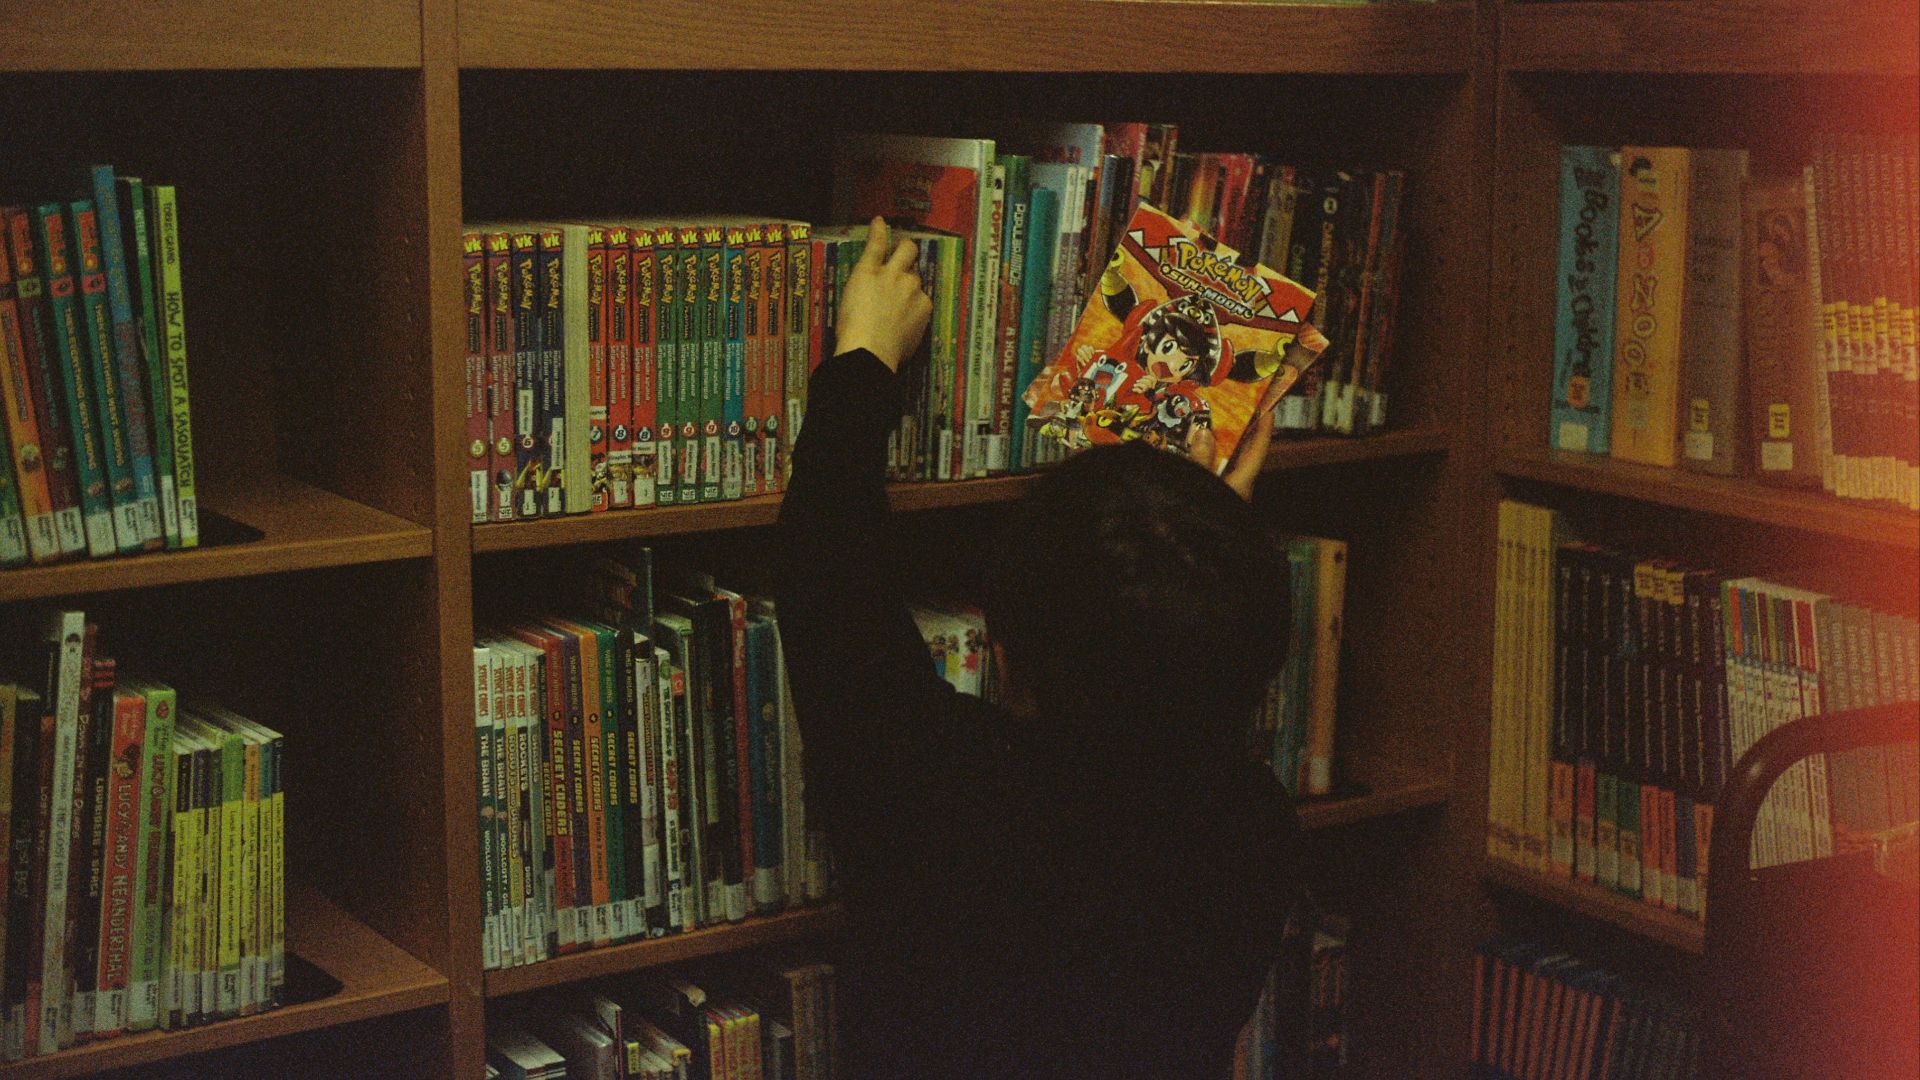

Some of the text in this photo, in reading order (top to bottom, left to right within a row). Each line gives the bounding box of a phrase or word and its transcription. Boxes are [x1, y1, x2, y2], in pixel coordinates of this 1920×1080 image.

[1168, 268, 1245, 318] SUN MOON
[1003, 340, 1015, 372] HOLE
[166, 292, 190, 488] HOW TO SPOT A SASQUATCH
[1001, 377, 1013, 404] NEW
[480, 733, 491, 797] THE BRAIN
[497, 737, 506, 799] THE BRAIN
[519, 733, 528, 790] ROCKETS
[553, 730, 567, 835] SECRET CODERS
[573, 739, 584, 813] SECRET CODERS
[590, 736, 602, 811] SECRET CODERS
[607, 731, 618, 805] SECRET CODERS
[627, 730, 638, 804] SECRET CODERS
[117, 784, 132, 816] LUCY
[89, 777, 104, 897] LOWRIDERS SPACE
[114, 835, 129, 868] ANDY
[483, 830, 493, 881] WOOLLCOTT
[500, 833, 508, 884] WOOLLCOTT
[107, 874, 130, 981] NEANDERTHAL
